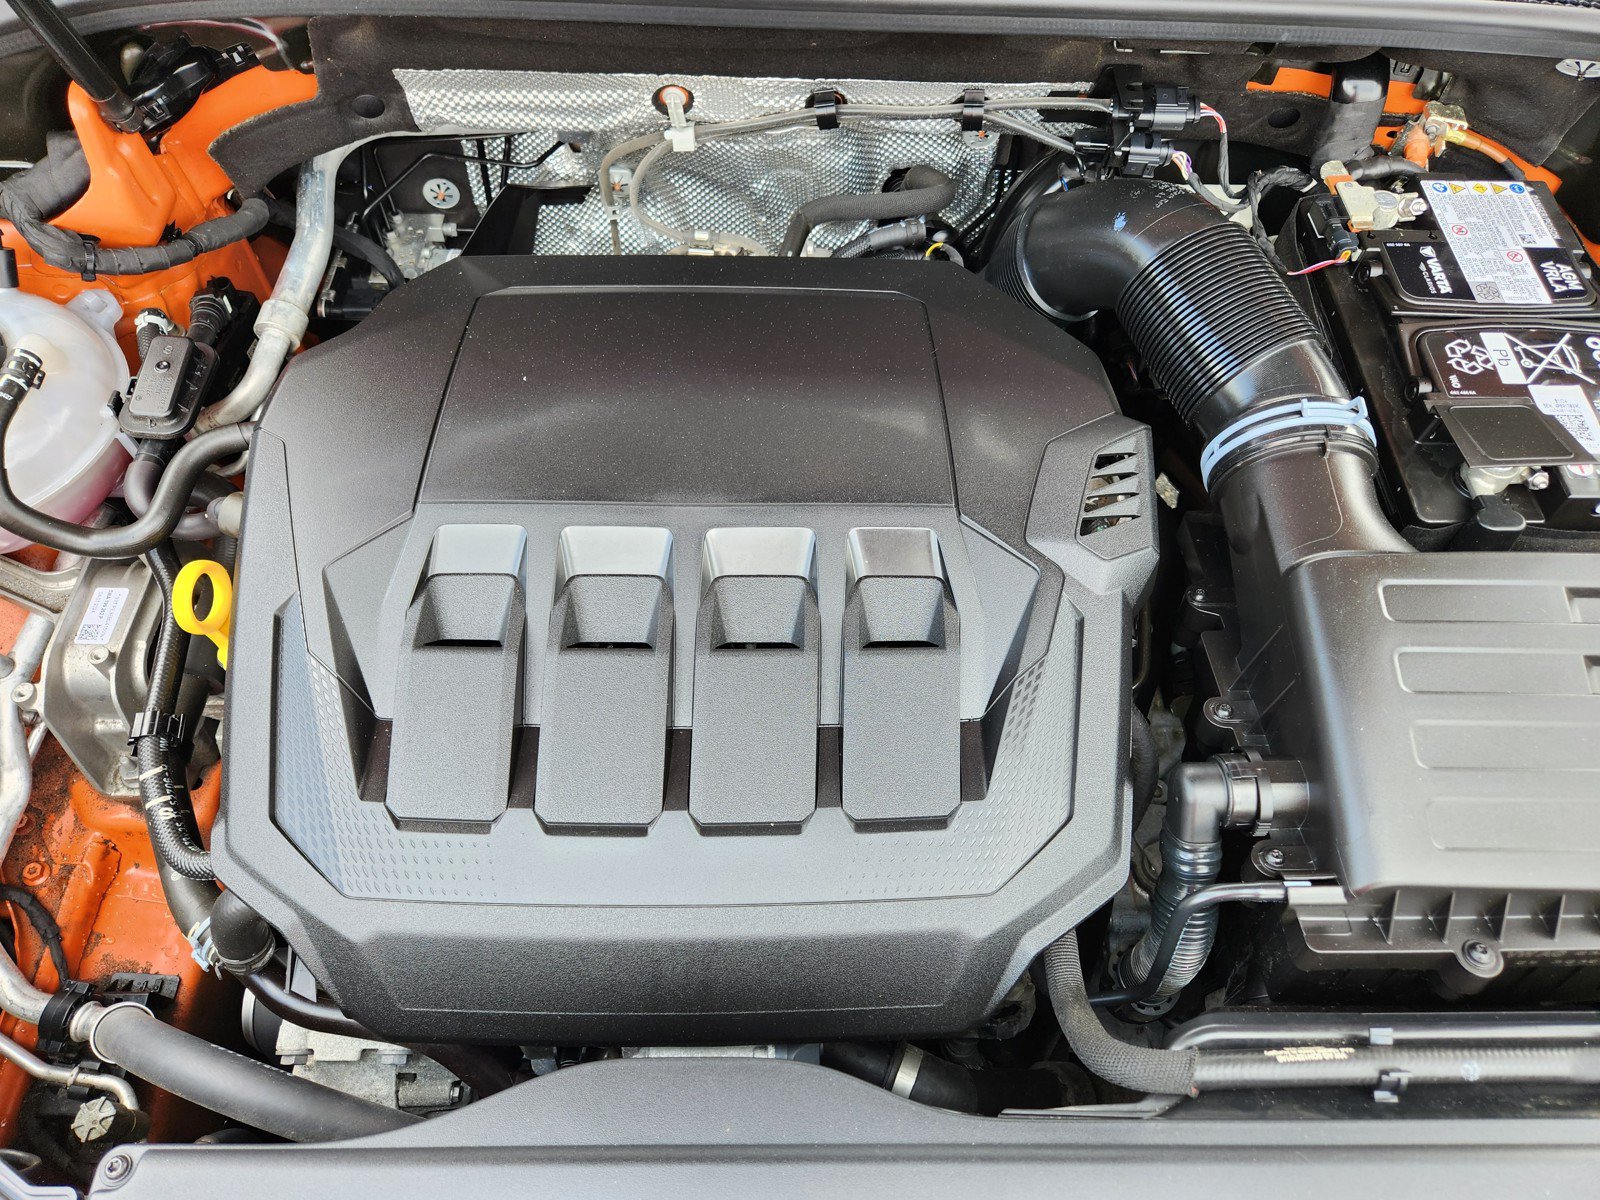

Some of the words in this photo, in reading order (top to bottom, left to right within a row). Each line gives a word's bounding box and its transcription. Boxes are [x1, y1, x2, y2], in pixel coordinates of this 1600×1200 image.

[1422, 271, 1437, 295] CLARIOS
[1426, 258, 1453, 295] VARTA
[1540, 261, 1567, 293] VRLA
[1556, 263, 1584, 291] AGM
[1493, 349, 1511, 367] Pb
